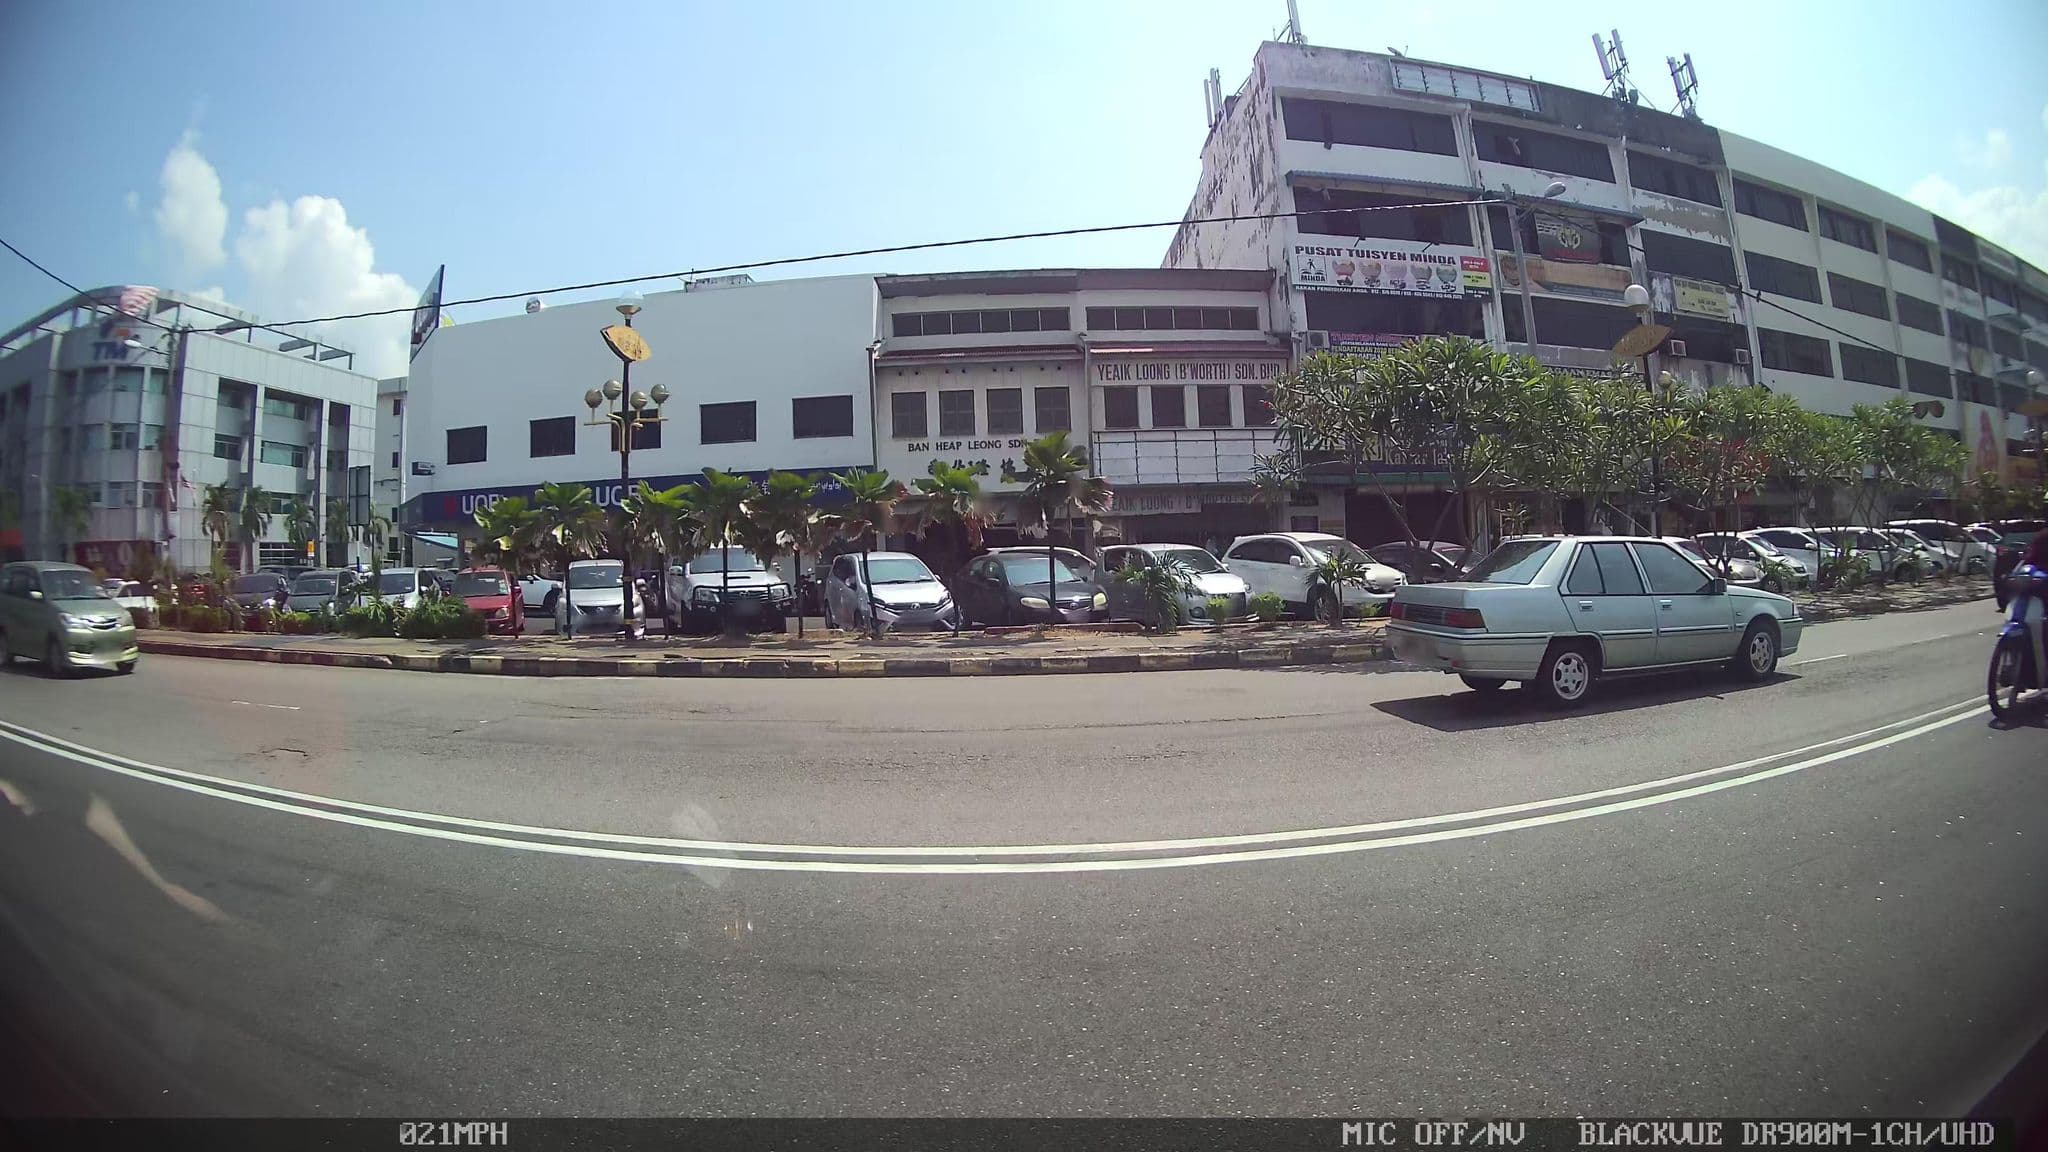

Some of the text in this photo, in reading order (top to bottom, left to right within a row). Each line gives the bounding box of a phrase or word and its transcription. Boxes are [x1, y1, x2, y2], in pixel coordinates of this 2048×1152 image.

[1295, 245, 1344, 257] PUSAT
[1346, 248, 1406, 260] TUISYEN
[1410, 253, 1456, 265] MINDA
[1097, 363, 1131, 381] YEAIK
[1136, 363, 1170, 380] LOONG
[1174, 363, 1231, 380] (B'WORTH)
[1235, 363, 1258, 380] SDN.
[908, 442, 930, 452] BAN
[936, 441, 962, 450] HEAP
[968, 440, 1002, 450] LEONG
